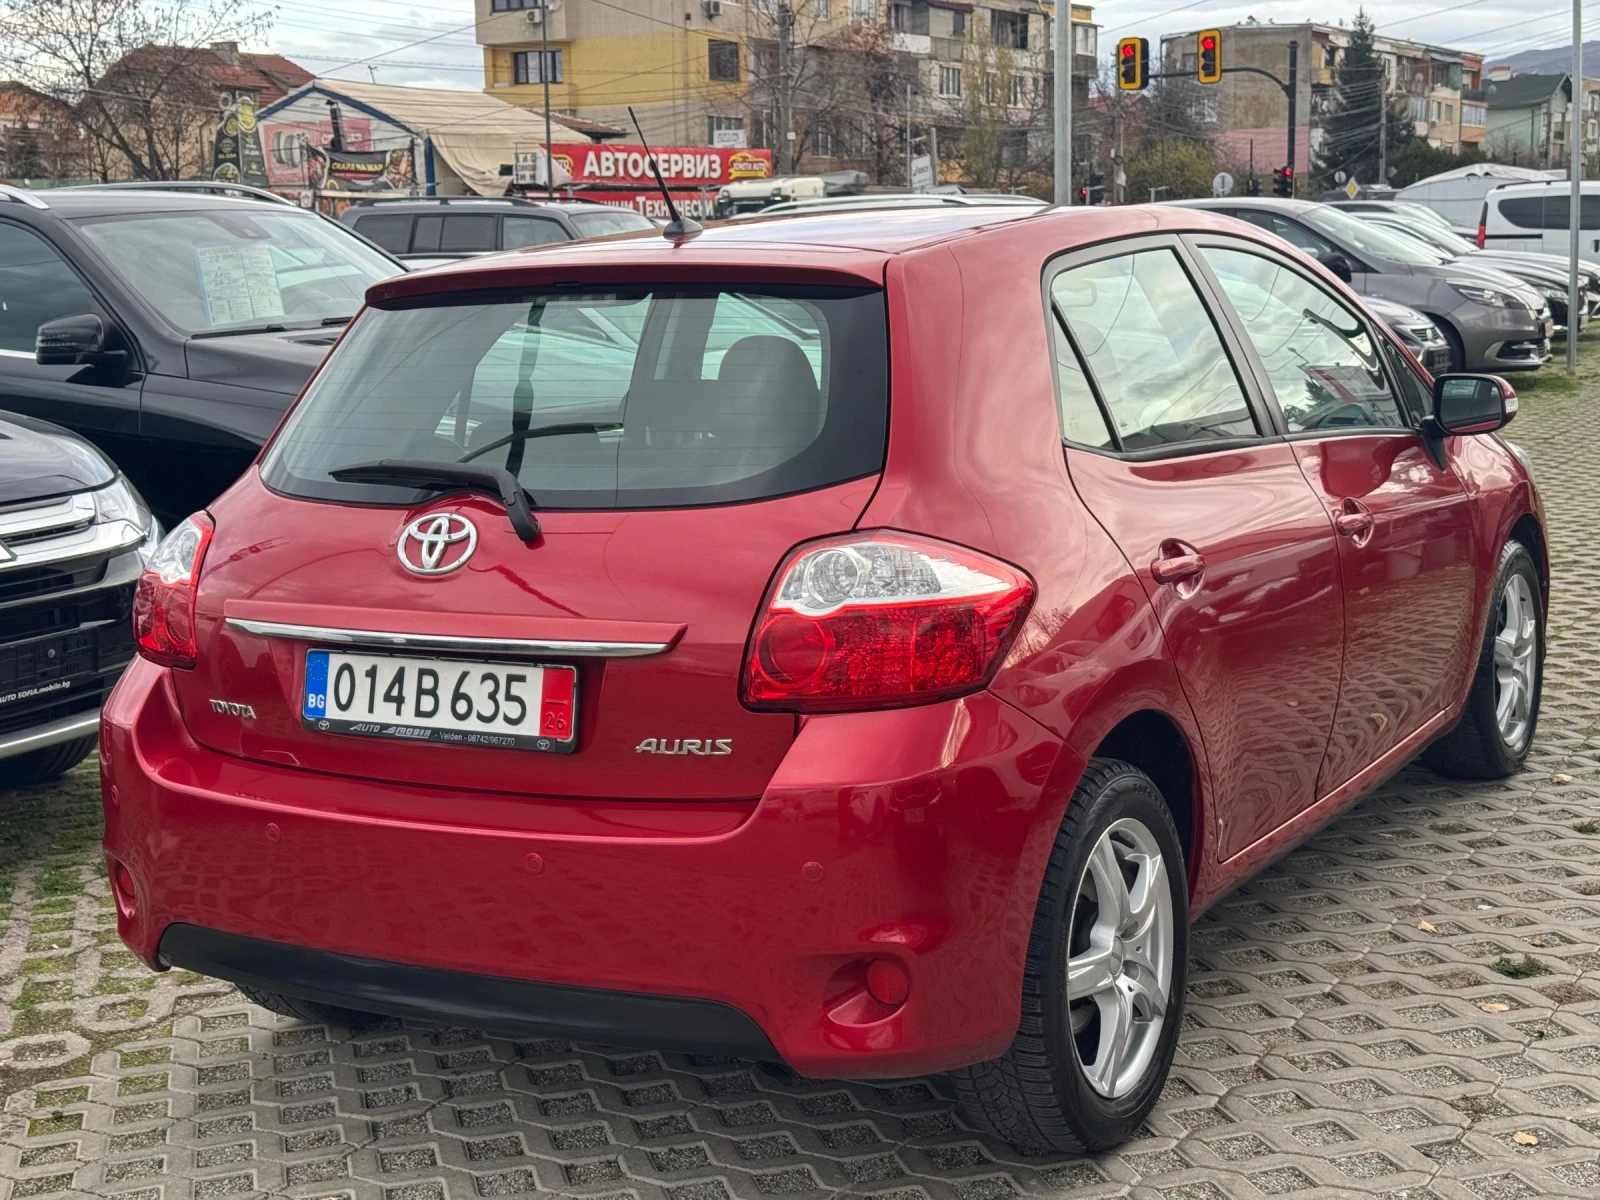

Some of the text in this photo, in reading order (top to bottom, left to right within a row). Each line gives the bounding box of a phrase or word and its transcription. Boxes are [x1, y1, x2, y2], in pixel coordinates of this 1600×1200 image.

[583, 150, 722, 180] АВТОСЕРВИЗ
[208, 698, 257, 719] TOYOTA
[308, 693, 325, 708] BG
[545, 711, 566, 730] 26
[349, 723, 381, 733] AUTO
[440, 731, 463, 742] Velden
[634, 738, 733, 756] AURIS
